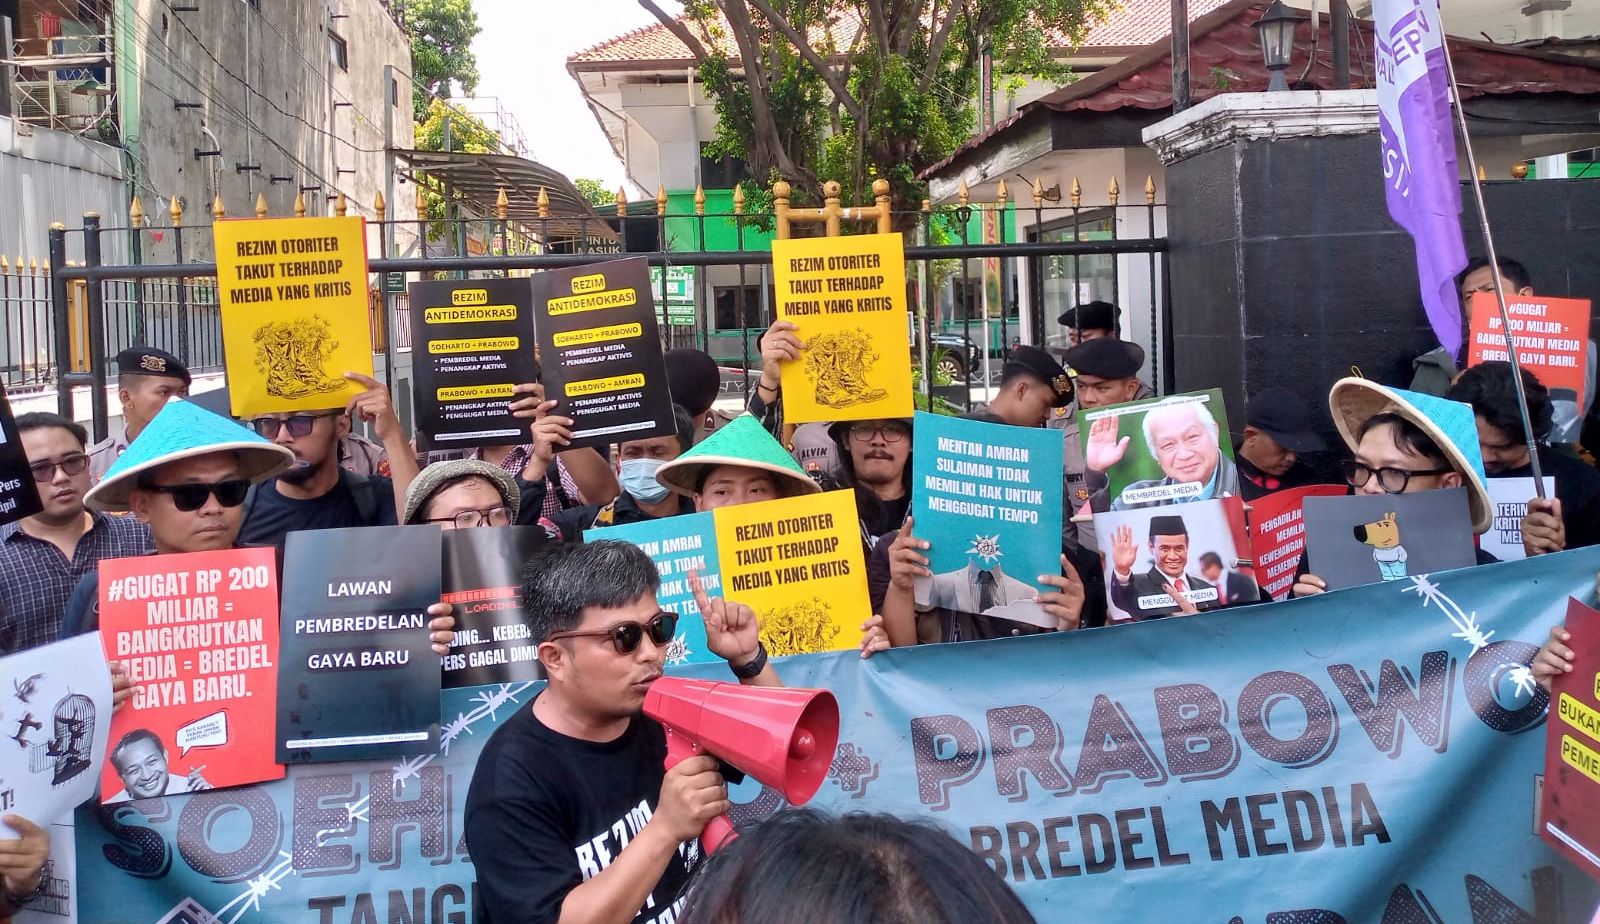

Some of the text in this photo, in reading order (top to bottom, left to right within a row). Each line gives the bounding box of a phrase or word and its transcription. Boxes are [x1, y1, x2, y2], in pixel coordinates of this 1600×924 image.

[237, 236, 339, 257] REZIM OTORITER
[235, 259, 343, 280] TAKUT TERHADAP
[790, 253, 880, 273] REZIM OTORITER
[230, 281, 352, 304] MEDIA YANG KRITIS
[573, 278, 604, 290] REZIM
[789, 275, 884, 294] TAKUT TERHADAP
[453, 292, 486, 303] REZIM
[549, 292, 635, 313] ANTIDEMOKRASI
[784, 296, 892, 316] MEDIA YANG KRITIS
[426, 308, 515, 321] ANTIDEMOKRASI
[1508, 303, 1548, 317] #GUGAT
[556, 332, 594, 343] SOEHARTO
[601, 326, 639, 338] PRABOWO
[1489, 317, 1503, 329] RP
[1526, 321, 1561, 334] MILIAR
[431, 342, 471, 351] SOEHARTO
[478, 340, 516, 348] PRABOWO
[604, 343, 626, 352] MEDIA
[1477, 332, 1580, 351] BANGUTKAN MEDIA
[607, 352, 633, 360] AKTIVIS
[1482, 349, 1511, 362] BRED
[1520, 352, 1546, 365] GAYA
[1548, 354, 1579, 368] BARU.
[440, 365, 481, 373] PENANGKAP
[440, 389, 478, 398] PRABOWO
[485, 387, 513, 395] AMRAN
[568, 382, 606, 393] PRABOWO
[614, 377, 641, 387] AMRAN
[617, 392, 642, 401] AKTIVIS
[446, 403, 486, 411] PENANGKAP
[577, 401, 641, 416] PENGGUGAT MEDIA
[938, 436, 1029, 463] MENTAN AMRAN
[936, 457, 1030, 483] SULAIMAN TIDAK
[925, 475, 1043, 505] MEMILIKI HAK UNTUK
[1125, 485, 1200, 501] MEMBREDEL MEDIA
[928, 496, 1038, 524] MENGGUGAT TEMPO
[736, 513, 834, 542] REZIM OTORITER
[1260, 509, 1302, 534] PENGADILAN
[662, 534, 703, 551] AMRAN
[736, 536, 839, 566] TAKUT TERHADAP
[1259, 538, 1303, 567] KEWENANGAN
[674, 554, 706, 575] TIDAK
[108, 565, 269, 602] #GUGAT RP 200
[732, 559, 850, 591] MEDIA YANG KRITIS
[328, 580, 392, 597] LAWAN
[662, 574, 721, 598] HAK UTUK
[1142, 591, 1214, 606] MENGGUT MEDIA
[147, 597, 219, 626] MILIAR
[295, 614, 424, 634] PEMBREDELAN
[117, 618, 263, 656] BANGKRUTKAN
[198, 644, 273, 675] BREDEL
[308, 650, 409, 669] GAYA BARU
[469, 648, 508, 668] GAGAL
[510, 645, 539, 662] DIMU
[132, 674, 253, 711] GAYA BARU.
[910, 640, 1549, 811] PRABOWO
[970, 804, 1191, 881] BREDEL
[1201, 783, 1392, 861] MEDIA
